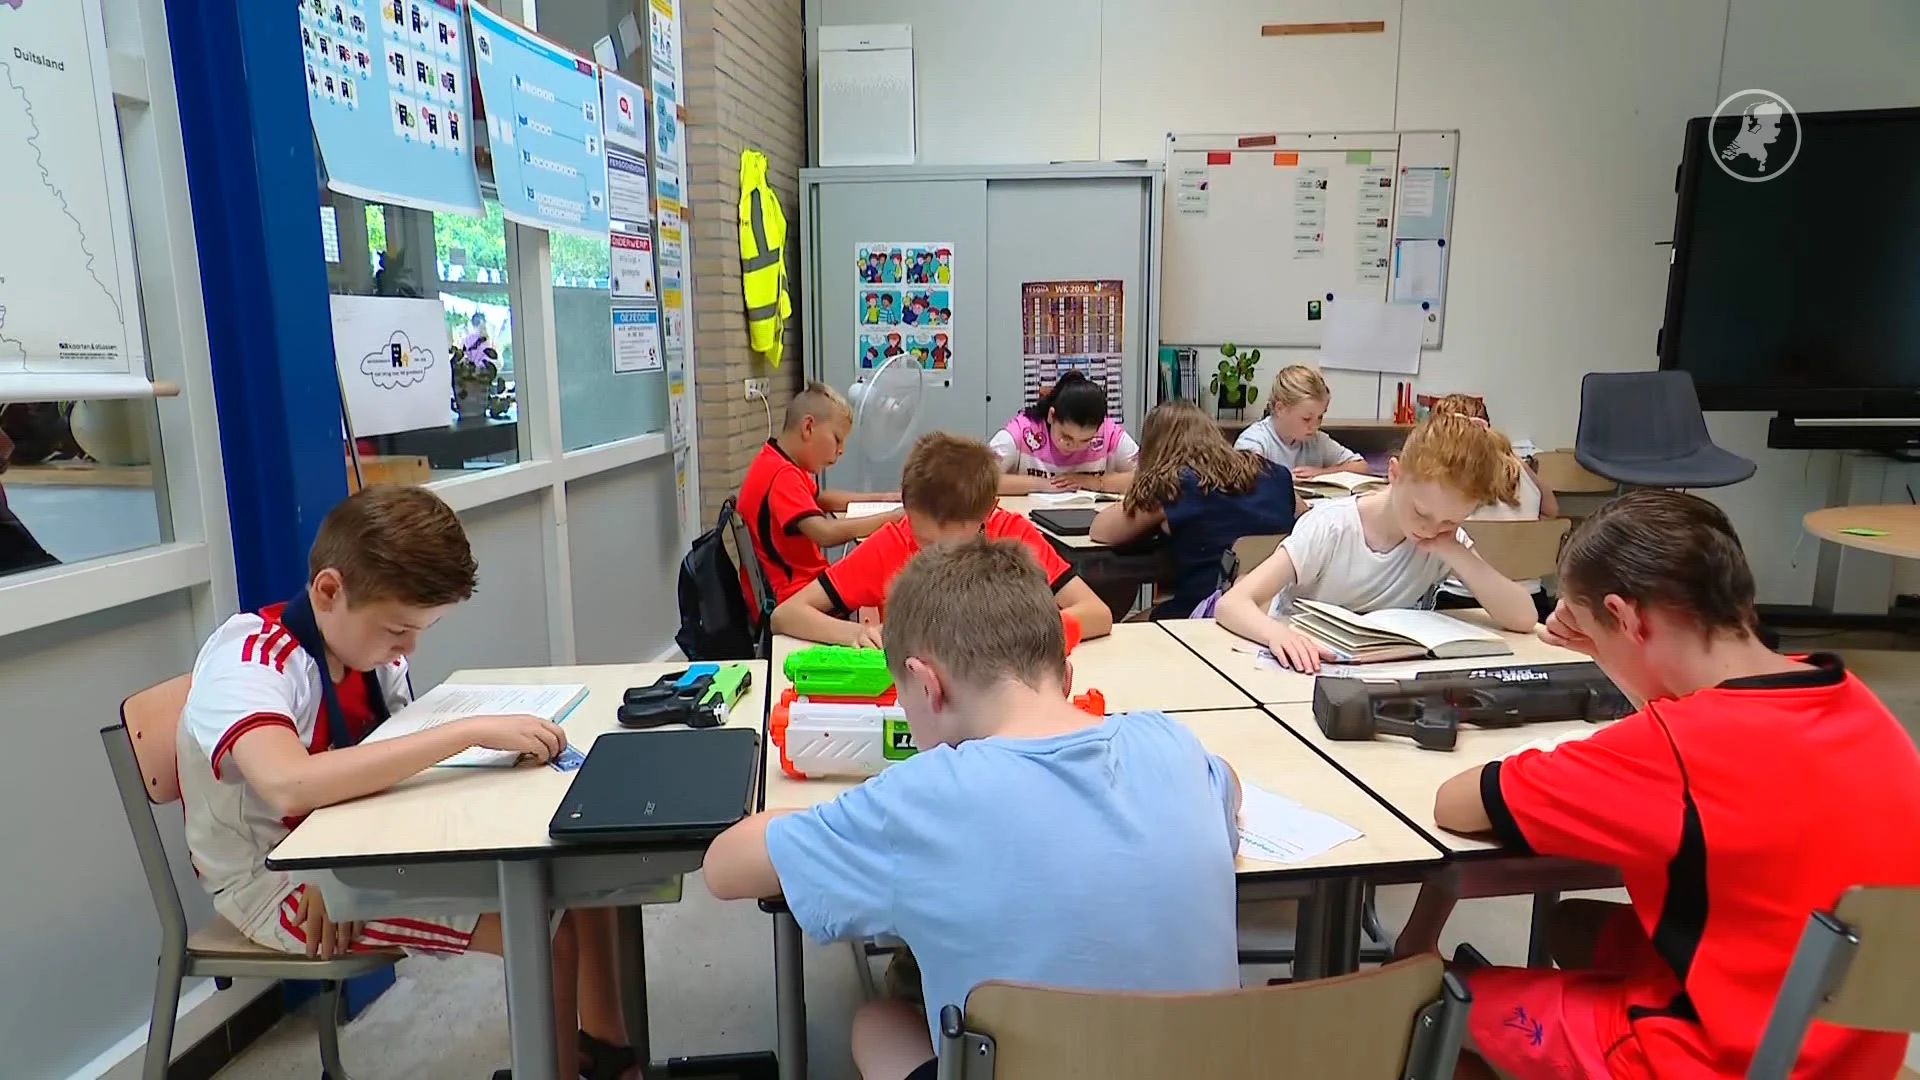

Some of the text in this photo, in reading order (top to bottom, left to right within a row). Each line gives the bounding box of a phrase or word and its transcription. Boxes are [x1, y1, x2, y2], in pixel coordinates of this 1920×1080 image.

[14, 47, 65, 71] Duitsland
[1055, 284, 1069, 293] WK
[1070, 284, 1090, 293] 2026
